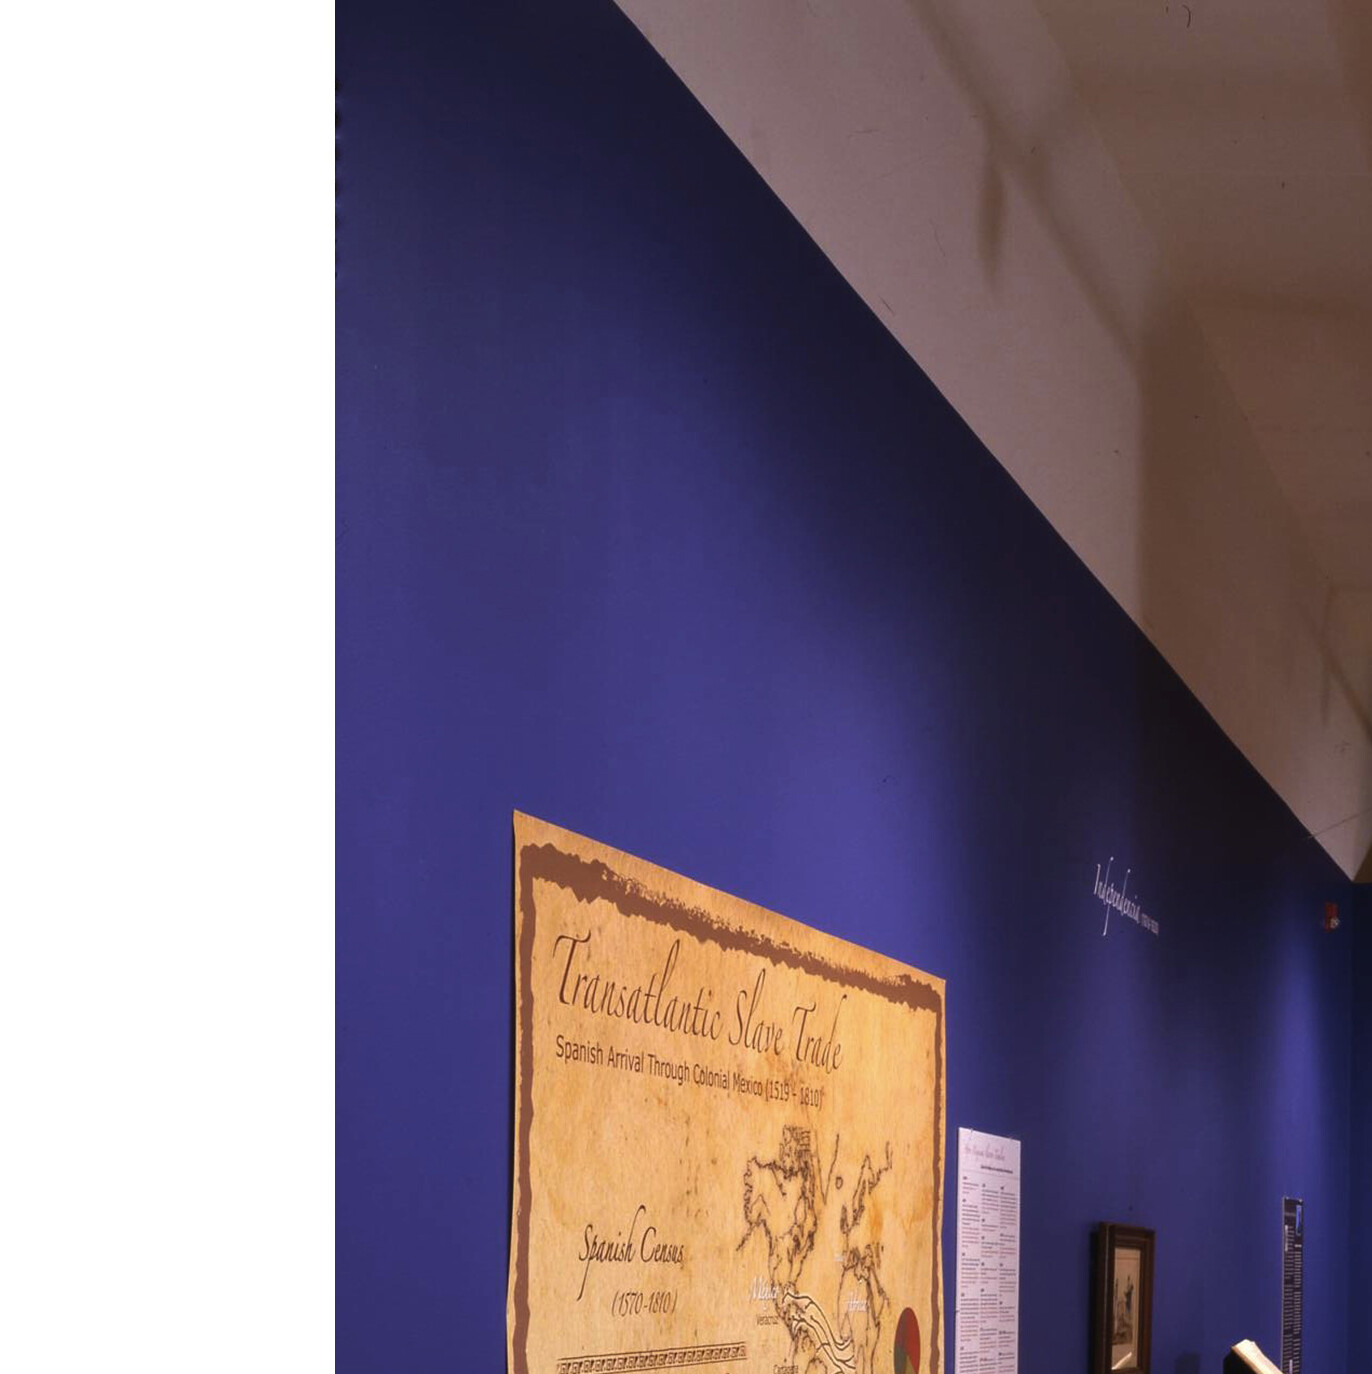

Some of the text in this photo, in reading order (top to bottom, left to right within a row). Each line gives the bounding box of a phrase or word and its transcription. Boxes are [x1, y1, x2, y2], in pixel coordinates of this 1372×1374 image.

[553, 930, 848, 1074] Transatlantic Slave Trade
[555, 1034, 603, 1066] Spanish
[607, 1046, 644, 1074] Arrival
[647, 1054, 690, 1086] Through
[693, 1063, 730, 1090] Colonial
[732, 1072, 763, 1097] Mexico
[765, 1078, 790, 1101] (1519
[800, 1084, 824, 1110] 1810)
[577, 1204, 686, 1302] Spanish Census
[611, 1289, 678, 1318] (1570-1810)
